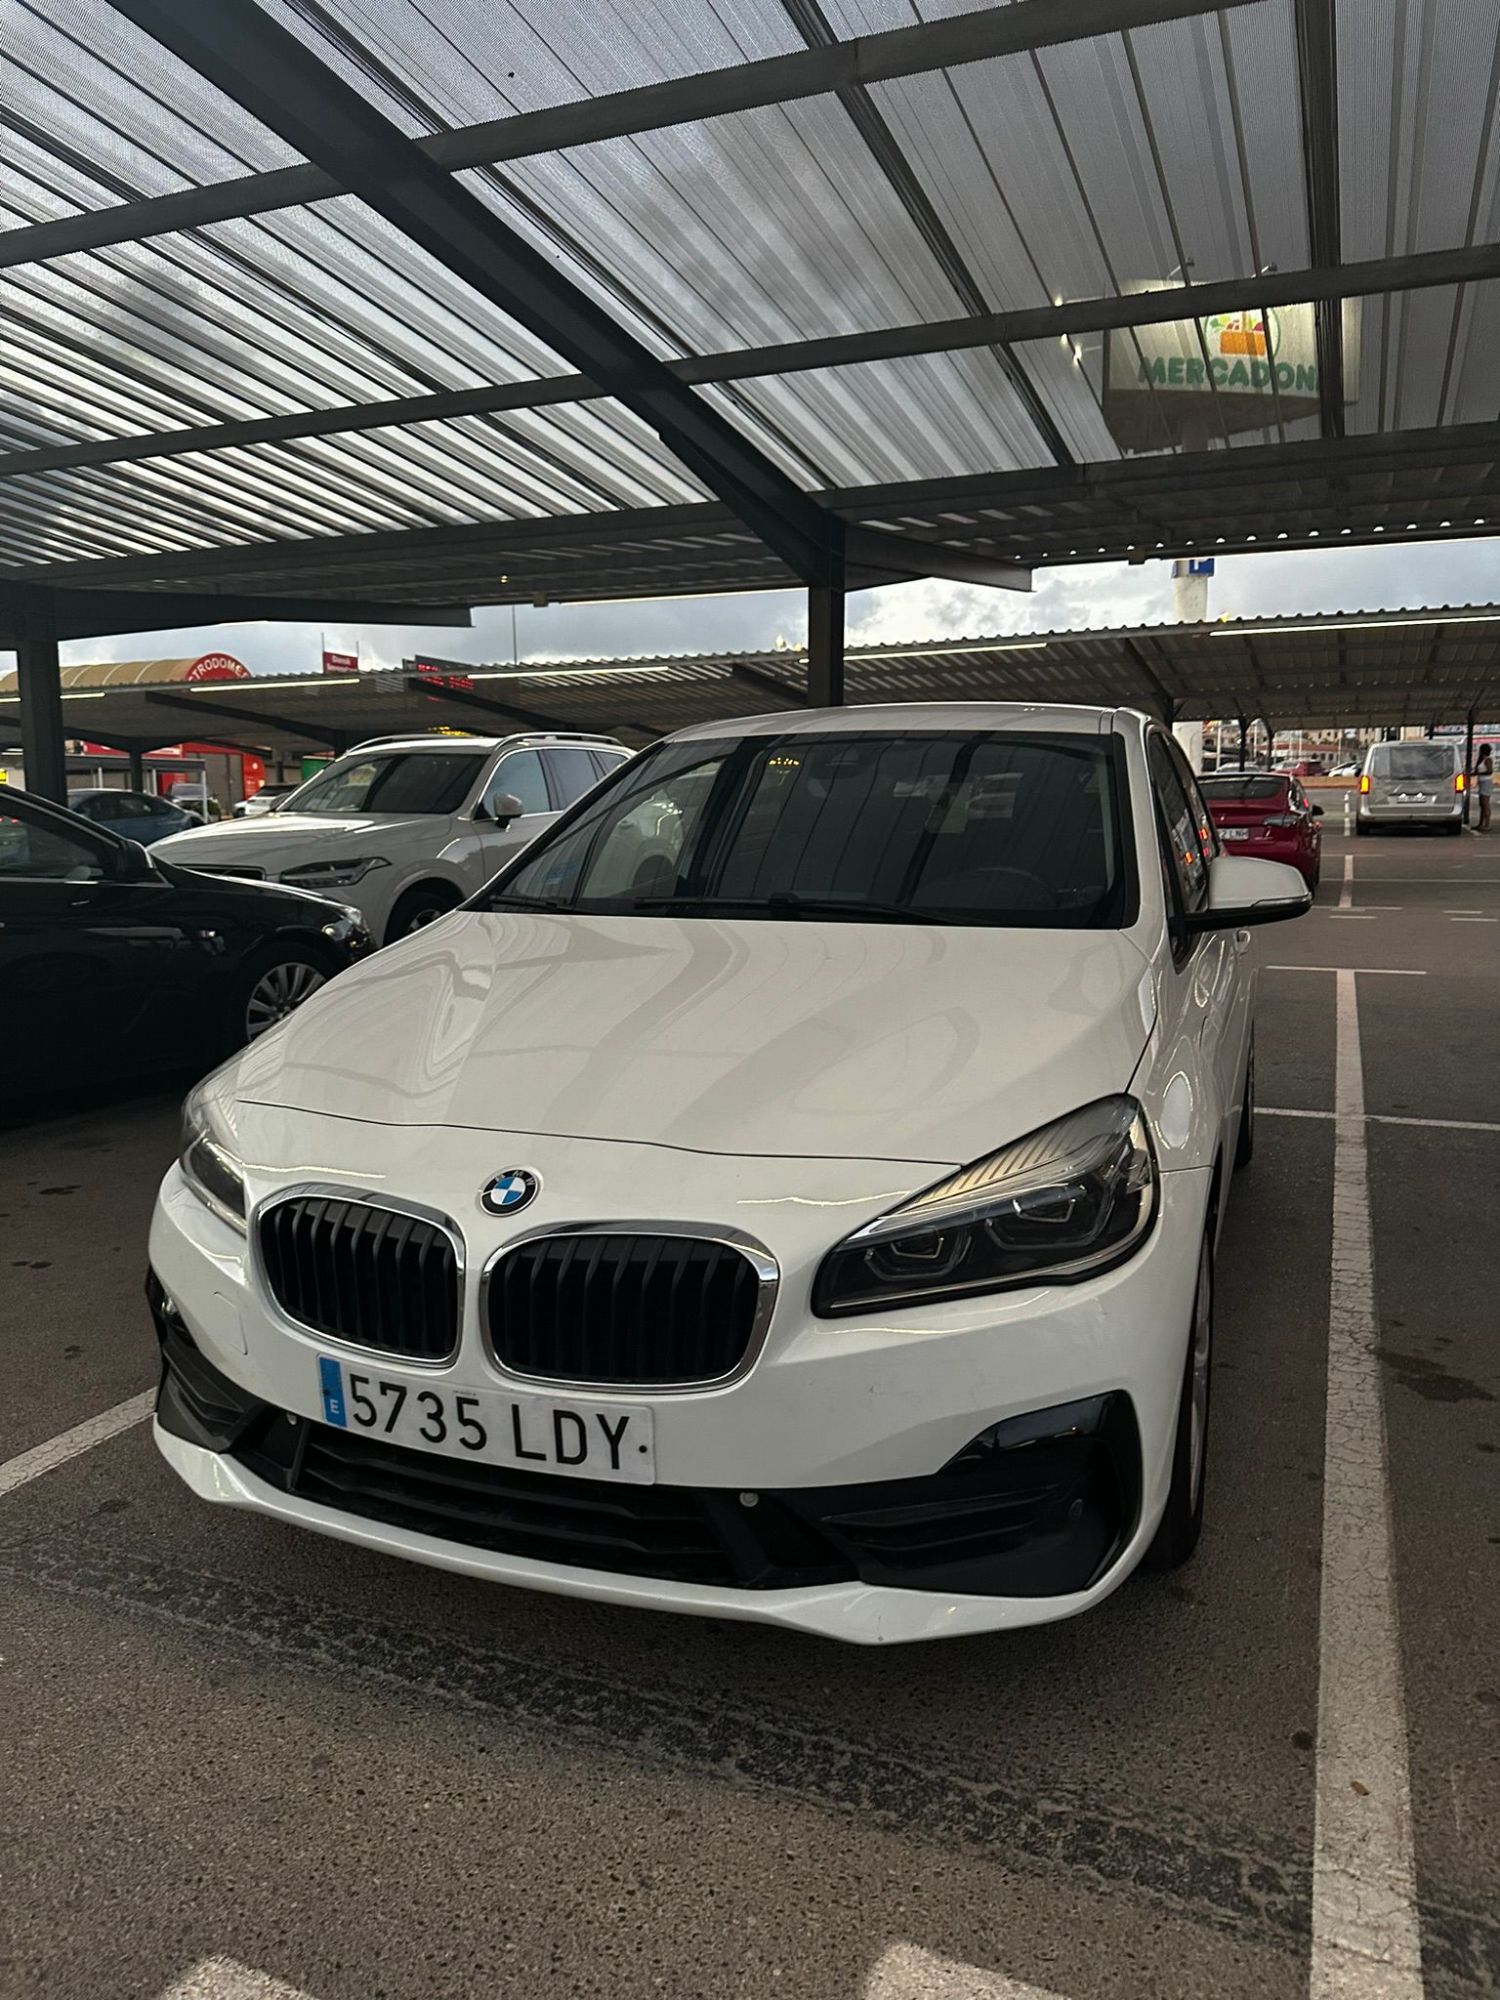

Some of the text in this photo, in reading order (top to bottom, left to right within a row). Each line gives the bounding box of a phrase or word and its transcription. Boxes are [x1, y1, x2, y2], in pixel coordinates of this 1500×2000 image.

[1138, 356, 1320, 391] MERCADON
[330, 1399, 340, 1414] E
[350, 1374, 630, 1470] 5735 LDY
